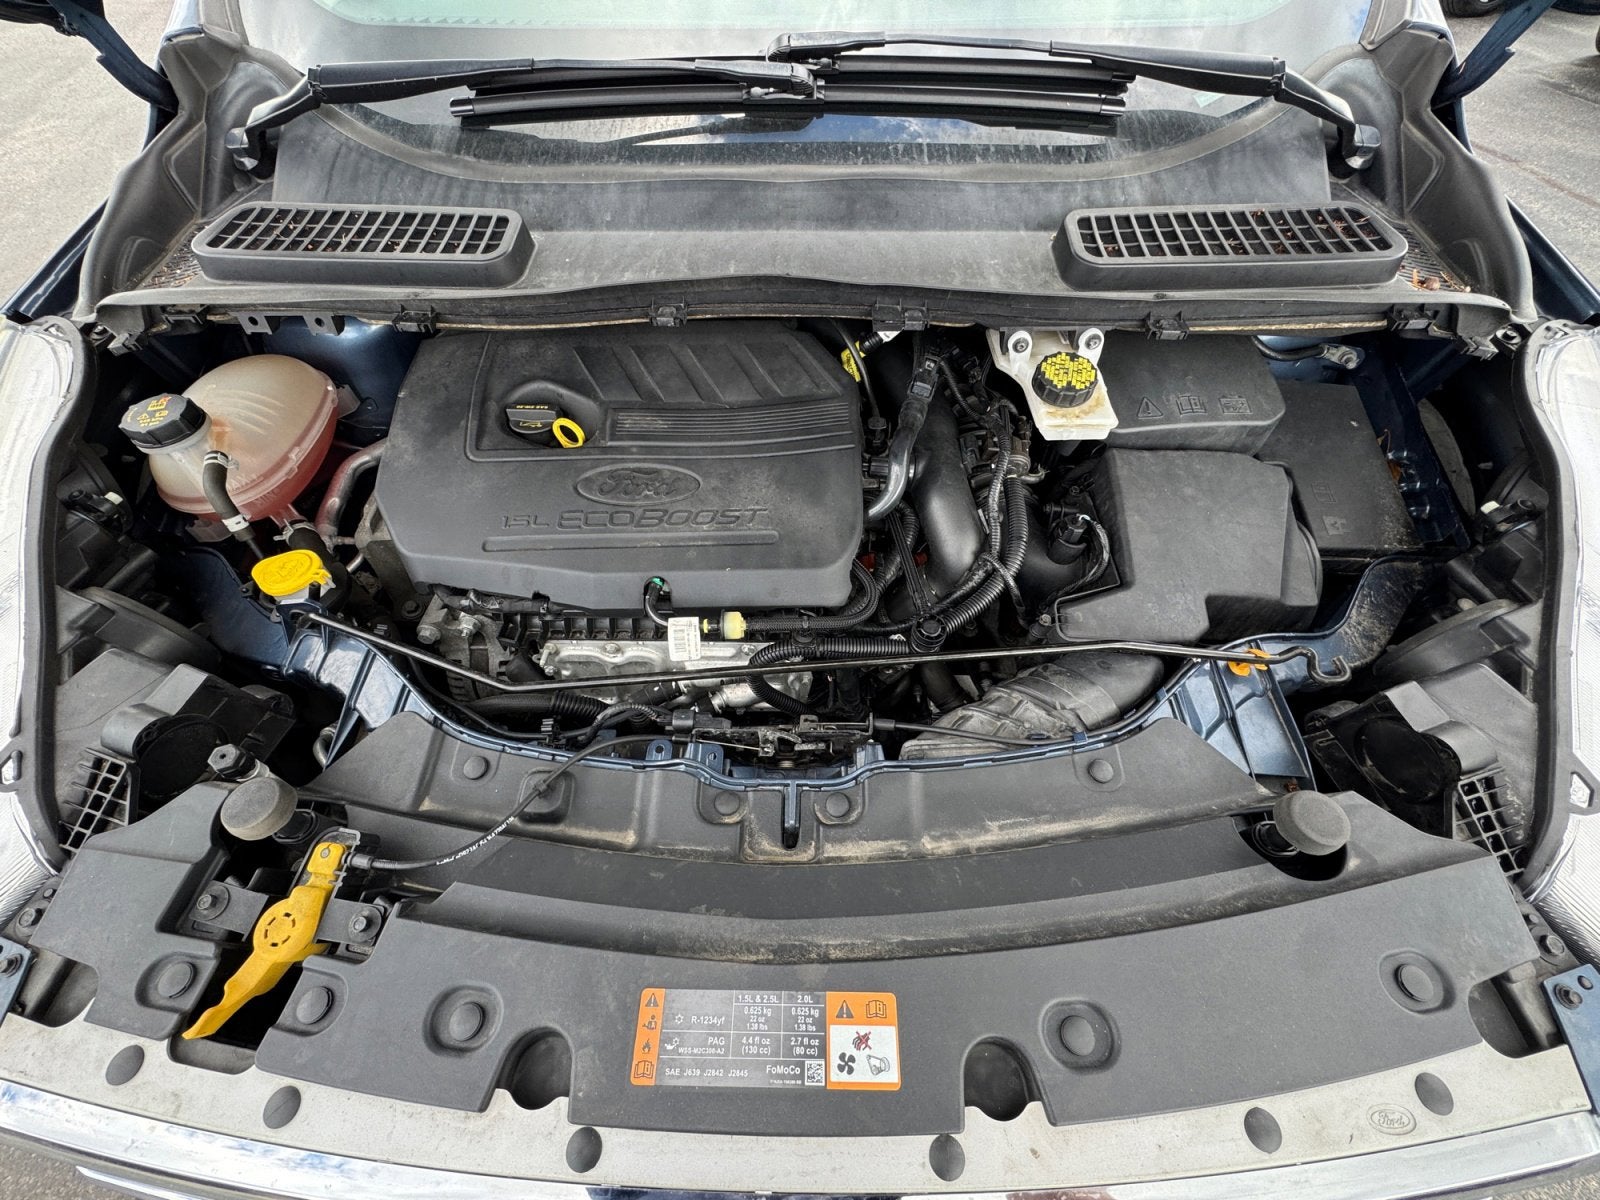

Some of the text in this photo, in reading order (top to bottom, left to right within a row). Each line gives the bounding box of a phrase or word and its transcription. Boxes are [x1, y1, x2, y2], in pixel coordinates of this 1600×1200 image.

[596, 466, 681, 499] Ford
[738, 994, 779, 1004] 1.5L & 2.5L
[797, 994, 814, 1004] 2.0L
[743, 1006, 772, 1017] 0.625 kg
[791, 1007, 819, 1018] 0.625 kg
[691, 1015, 725, 1027] R-1234yf
[759, 1023, 768, 1031] lbs
[807, 1024, 816, 1032] lbs
[708, 1036, 725, 1046] PAG
[741, 1036, 753, 1044] 4.4
[754, 1036, 760, 1044] fl
[790, 1037, 801, 1046] 2.7
[803, 1037, 809, 1046] fl
[741, 1045, 771, 1056] (130 cc)
[792, 1046, 818, 1057] (80 cc)
[665, 1067, 749, 1078] SAE J639 J2842 J2845
[766, 1064, 801, 1075] FoMoCo
